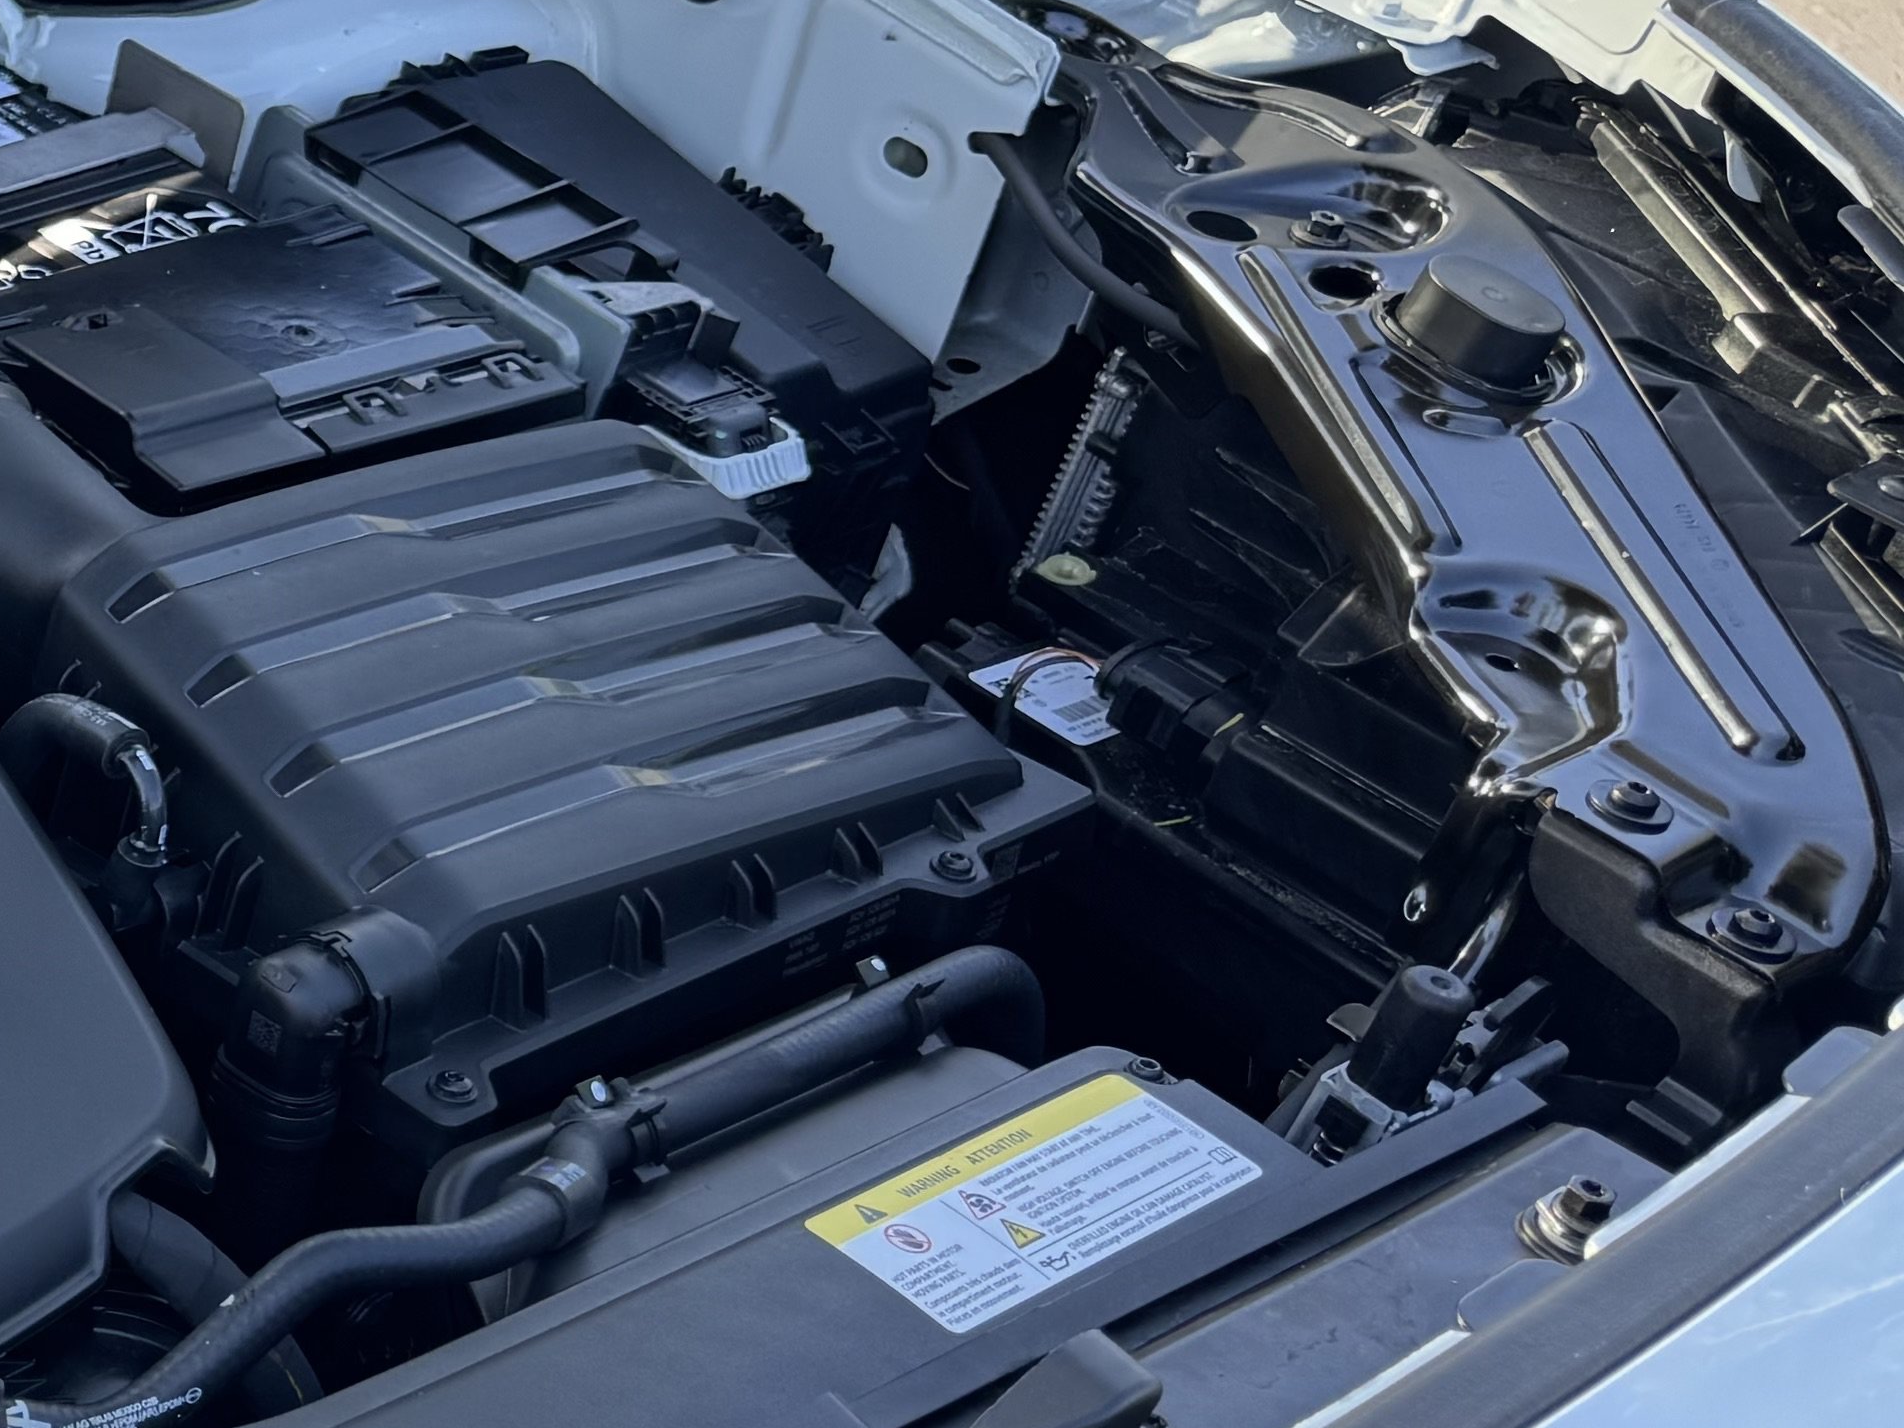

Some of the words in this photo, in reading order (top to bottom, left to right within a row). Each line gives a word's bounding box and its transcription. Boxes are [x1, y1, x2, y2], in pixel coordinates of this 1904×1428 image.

[1038, 1143, 1063, 1157] START
[895, 1164, 962, 1199] WARNING
[962, 1128, 1035, 1165] ATTENTION
[1085, 1166, 1104, 1177] OFF
[1098, 1154, 1127, 1170] ENGINE
[1065, 1225, 1111, 1251] OVERFILLED
[1104, 1213, 1134, 1230] ENGINE
[1128, 1207, 1145, 1218] OIL
[1139, 1200, 1159, 1212] CAN
[1153, 1186, 1186, 1205] DAMAGE
[933, 1243, 964, 1260] MOTOR
